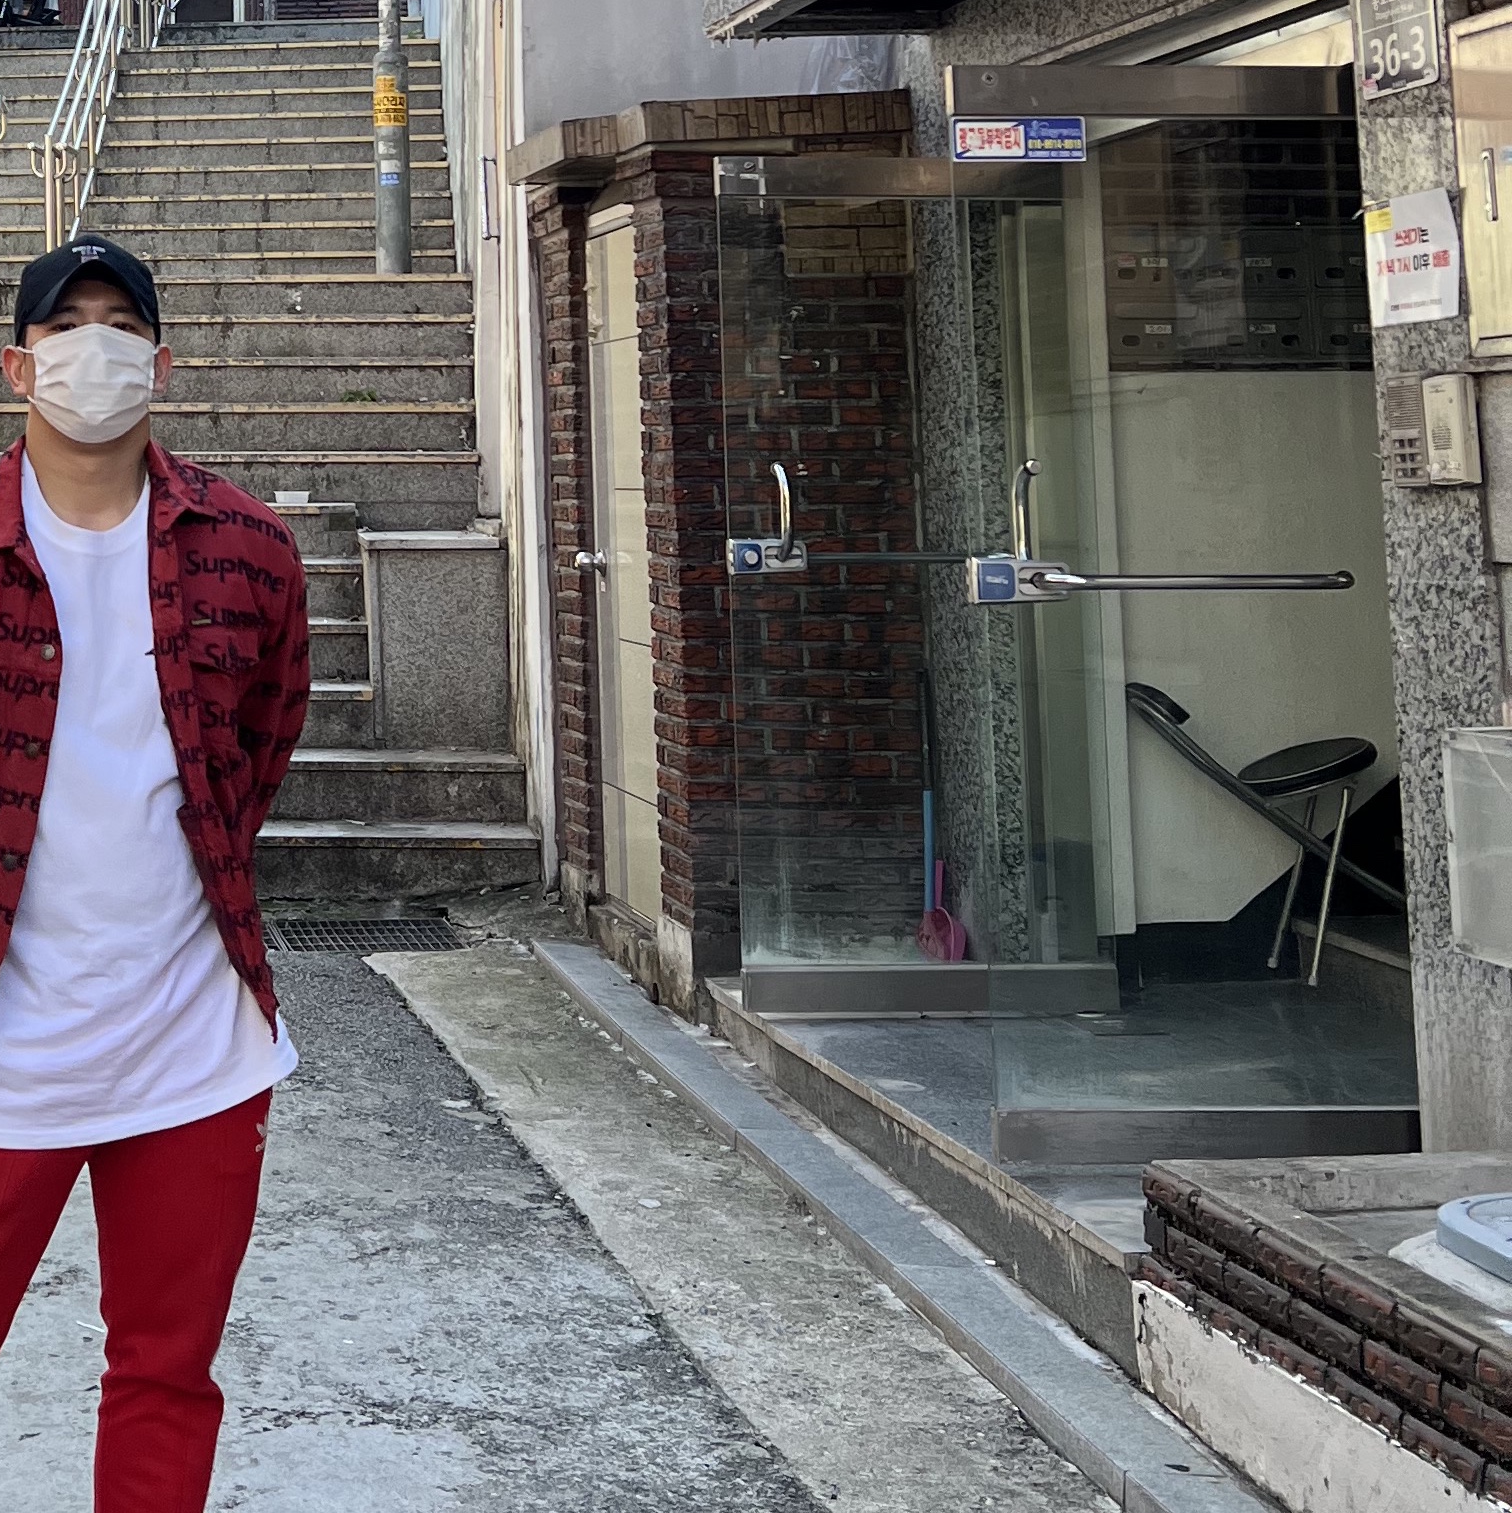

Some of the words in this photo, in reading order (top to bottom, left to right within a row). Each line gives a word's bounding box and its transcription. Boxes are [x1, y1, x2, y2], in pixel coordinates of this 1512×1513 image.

[1369, 25, 1427, 81] 36-3
[1395, 226, 1430, 247] 쓰레기는
[1412, 253, 1431, 271] 이후
[210, 508, 290, 546] preme
[185, 549, 287, 594] Supreme
